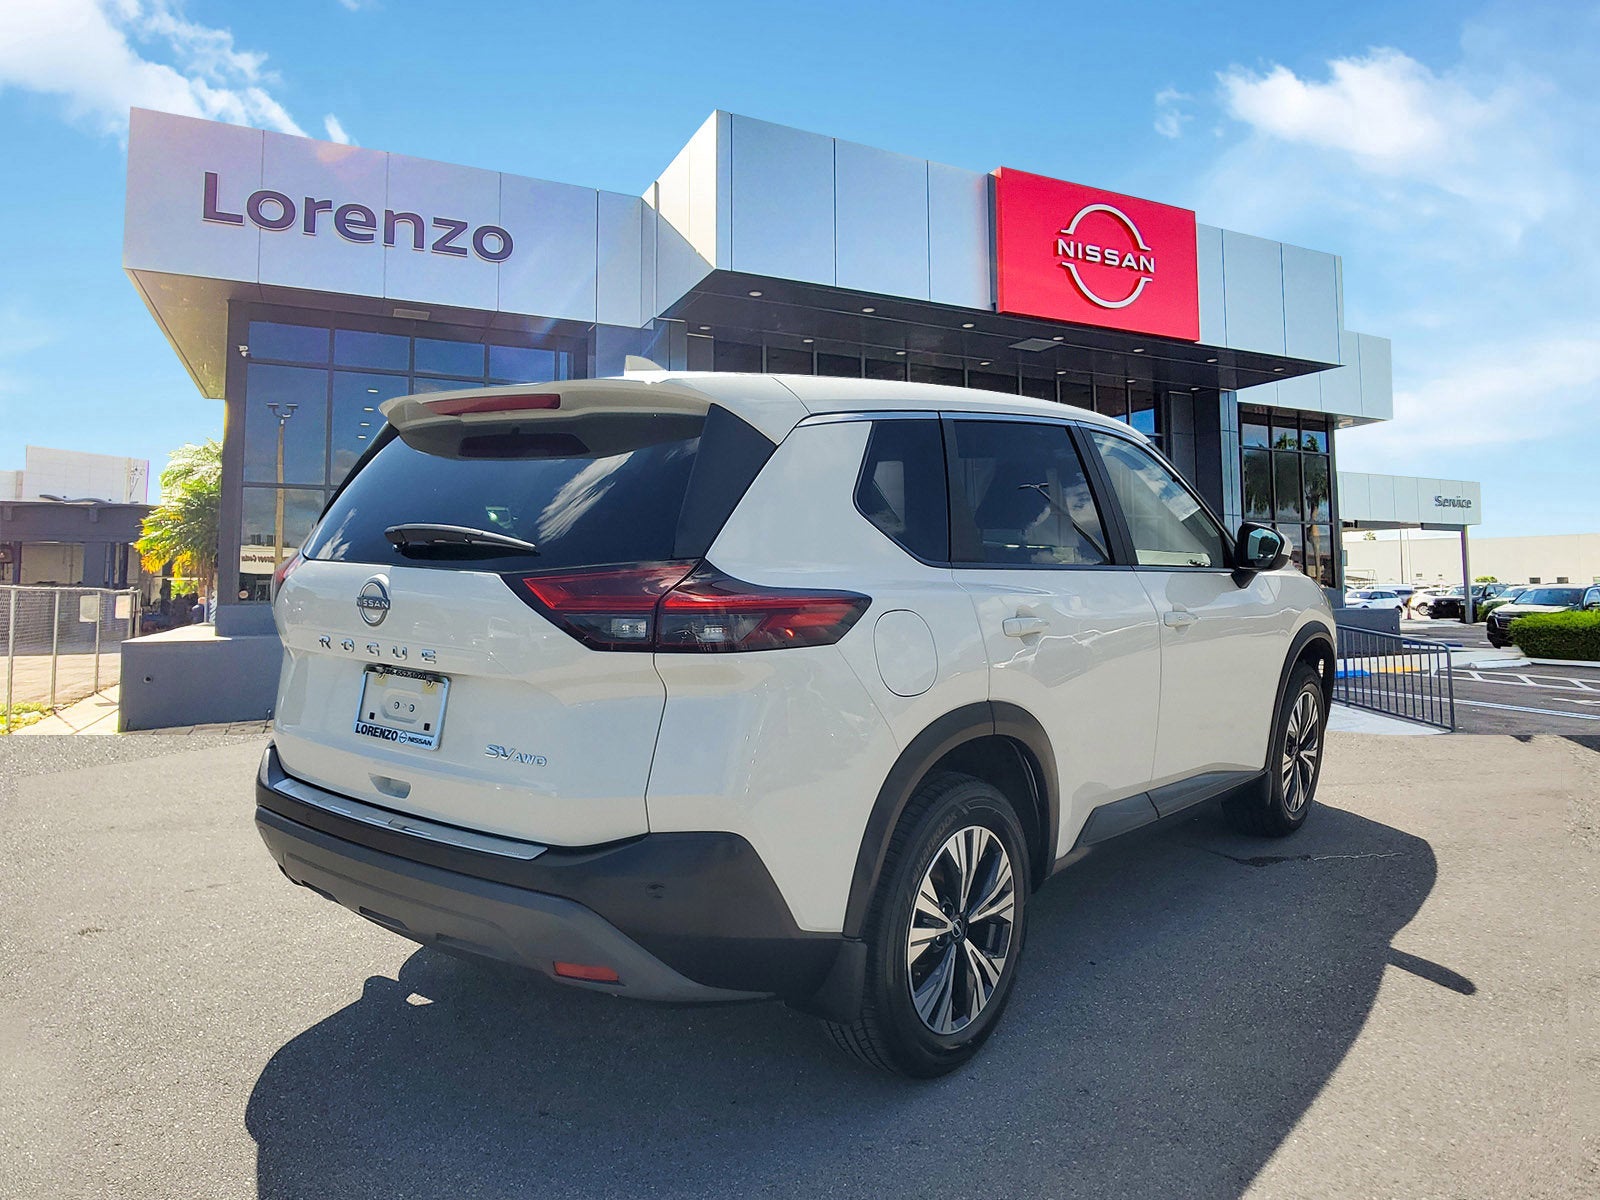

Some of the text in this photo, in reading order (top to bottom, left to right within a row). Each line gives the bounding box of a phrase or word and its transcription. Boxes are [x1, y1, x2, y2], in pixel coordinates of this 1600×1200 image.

[203, 171, 514, 262] Lorenzo
[1057, 238, 1155, 273] NISSAN
[1434, 495, 1472, 508] Service
[319, 634, 437, 664] ROGUE
[355, 723, 433, 746] LORENZO NISSAN
[484, 744, 548, 767] SV AWD
